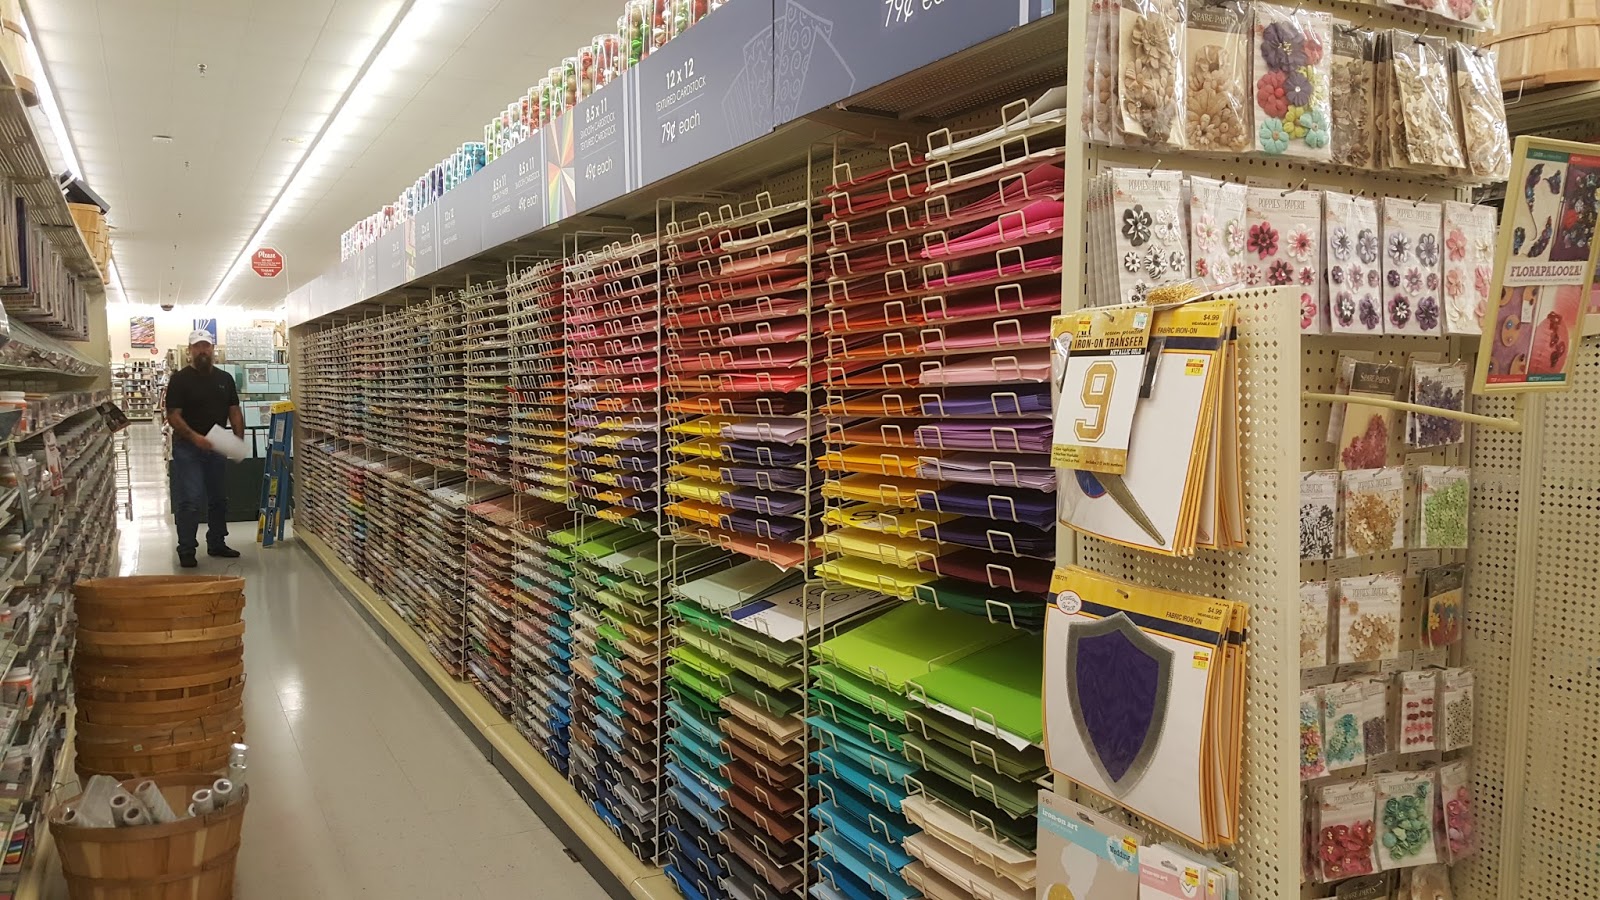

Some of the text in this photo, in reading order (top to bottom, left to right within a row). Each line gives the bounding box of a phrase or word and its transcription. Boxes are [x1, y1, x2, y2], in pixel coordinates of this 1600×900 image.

[666, 57, 694, 90] 12 x 12
[655, 75, 707, 112] TEXTURED CARDSTOCK
[585, 104, 595, 124] 8.5
[600, 97, 608, 114] 11
[661, 109, 701, 144] 79¢ each
[596, 156, 613, 176] each
[1258, 197, 1281, 209] POPPIES
[1510, 265, 1583, 278] FLORAPALOOZA!
[1203, 313, 1220, 321] $4.99
[1157, 327, 1198, 335] FABRIC IRON-ON
[1074, 339, 1104, 349] IRON-ON
[1105, 336, 1144, 349] TRANSFER
[1073, 360, 1118, 443] 9
[1165, 611, 1202, 625] FABRIC IRON-ON
[1207, 606, 1223, 616] $4.99
[1042, 807, 1079, 831] iron-on art
[1109, 845, 1131, 863] Wedding
